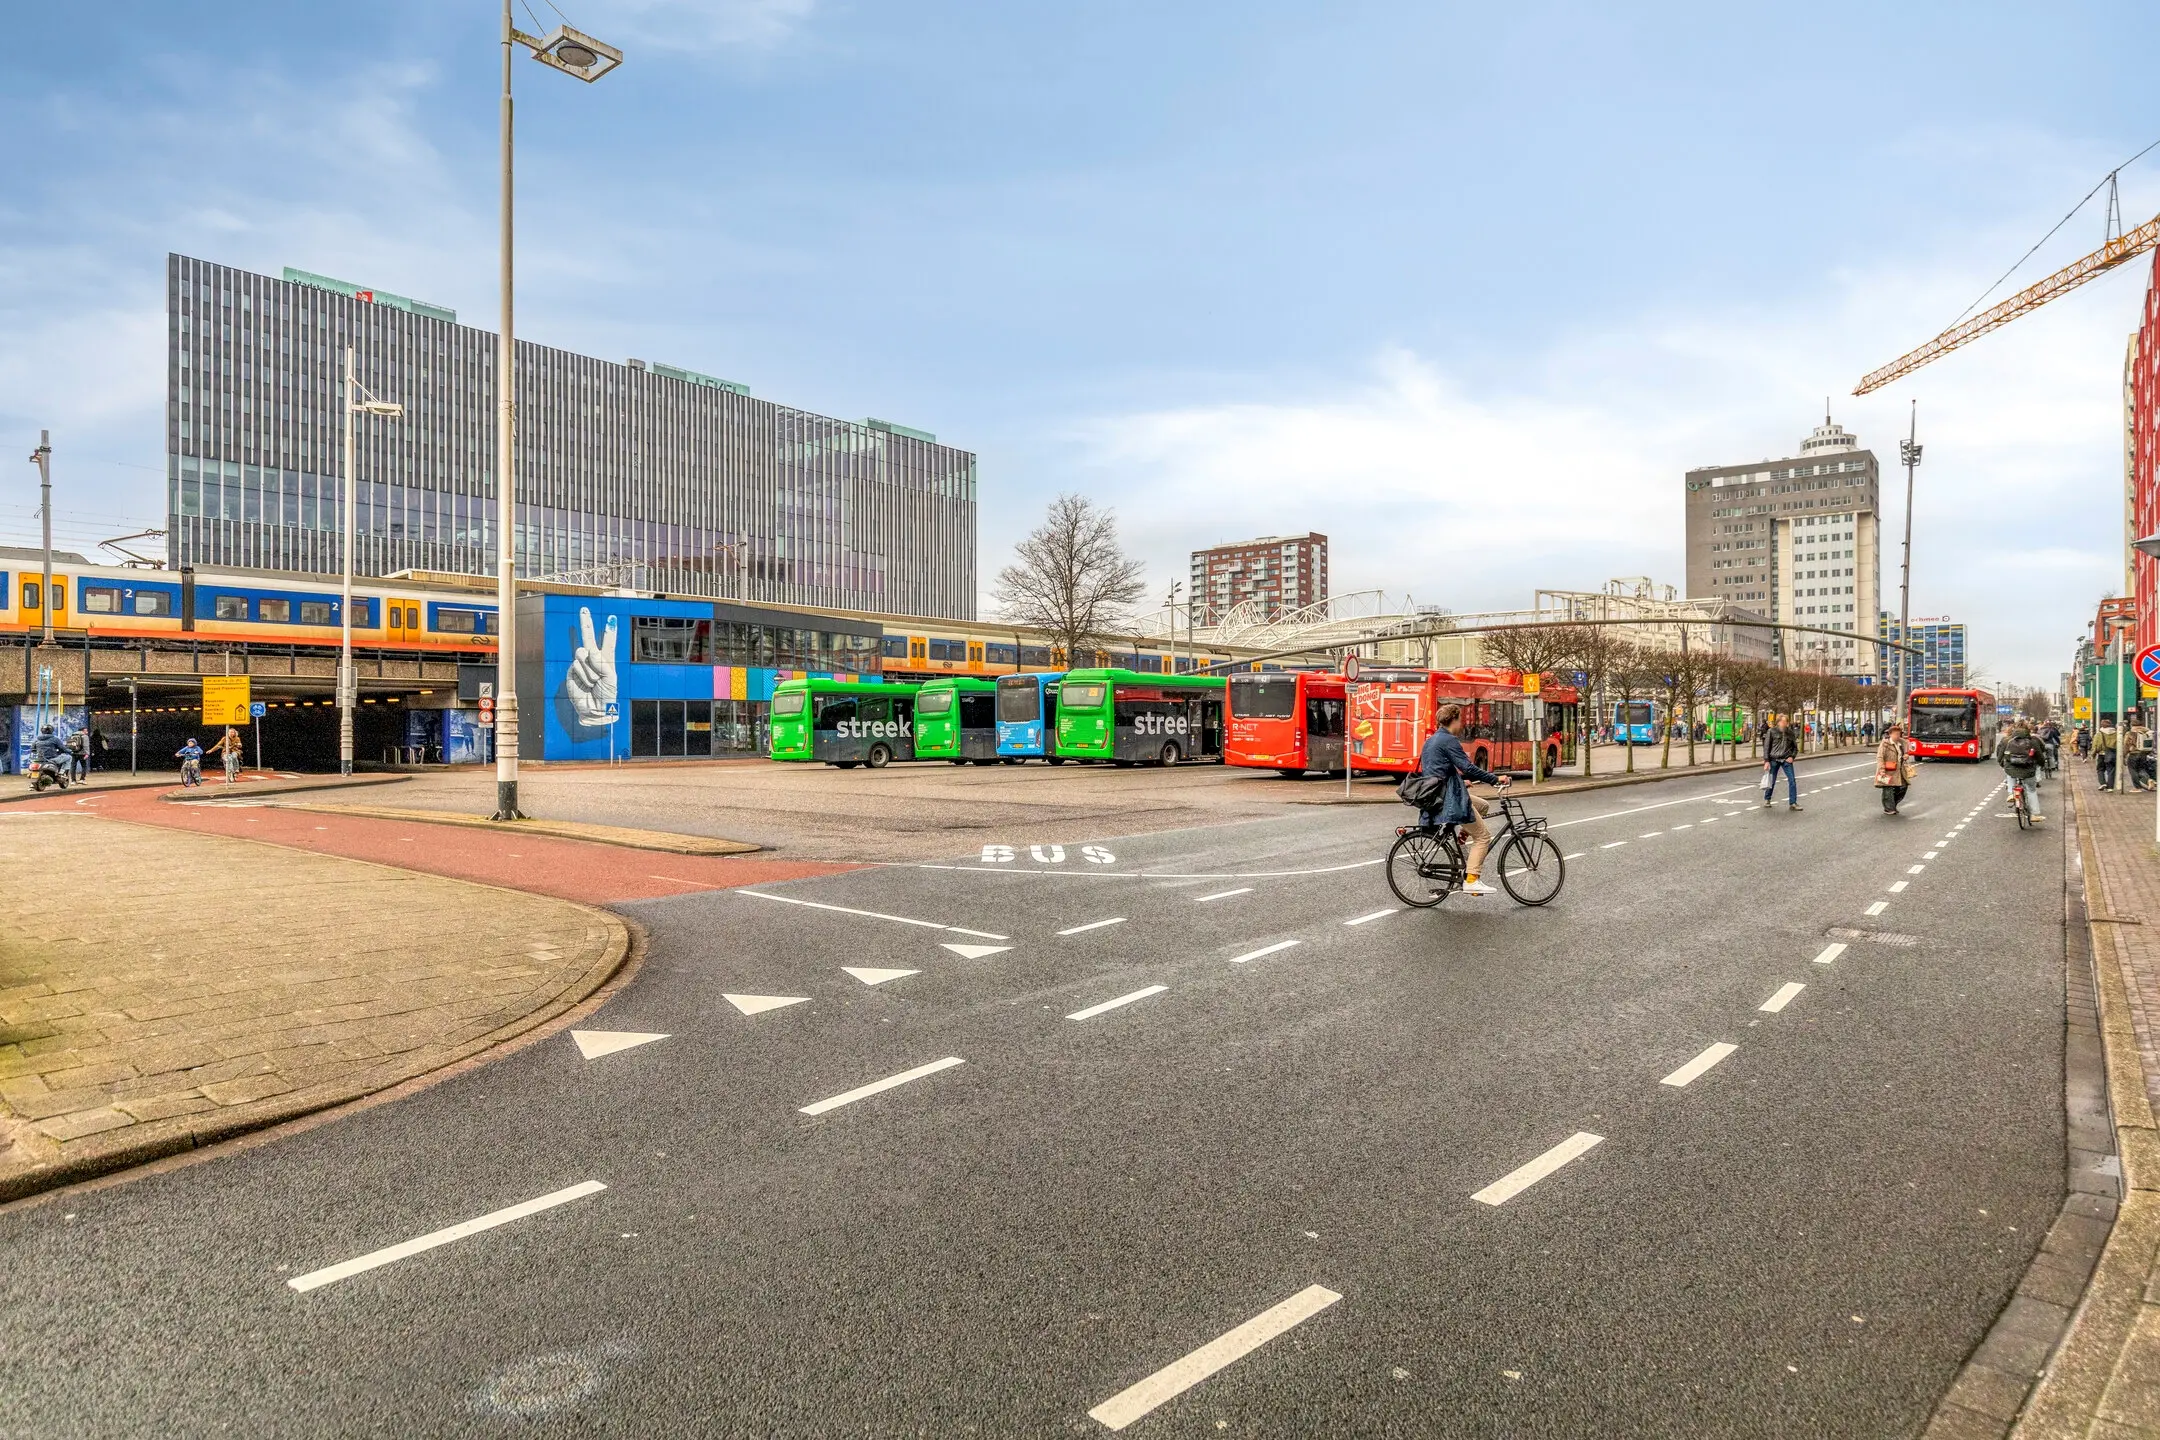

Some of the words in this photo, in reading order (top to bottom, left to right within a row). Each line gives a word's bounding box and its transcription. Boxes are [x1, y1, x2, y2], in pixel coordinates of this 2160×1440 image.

[124, 588, 133, 598] 2
[331, 602, 339, 611] 2
[478, 612, 483, 620] 1
[836, 714, 912, 738] streek
[1134, 711, 1190, 735] stree
[981, 844, 1117, 864] BUS
